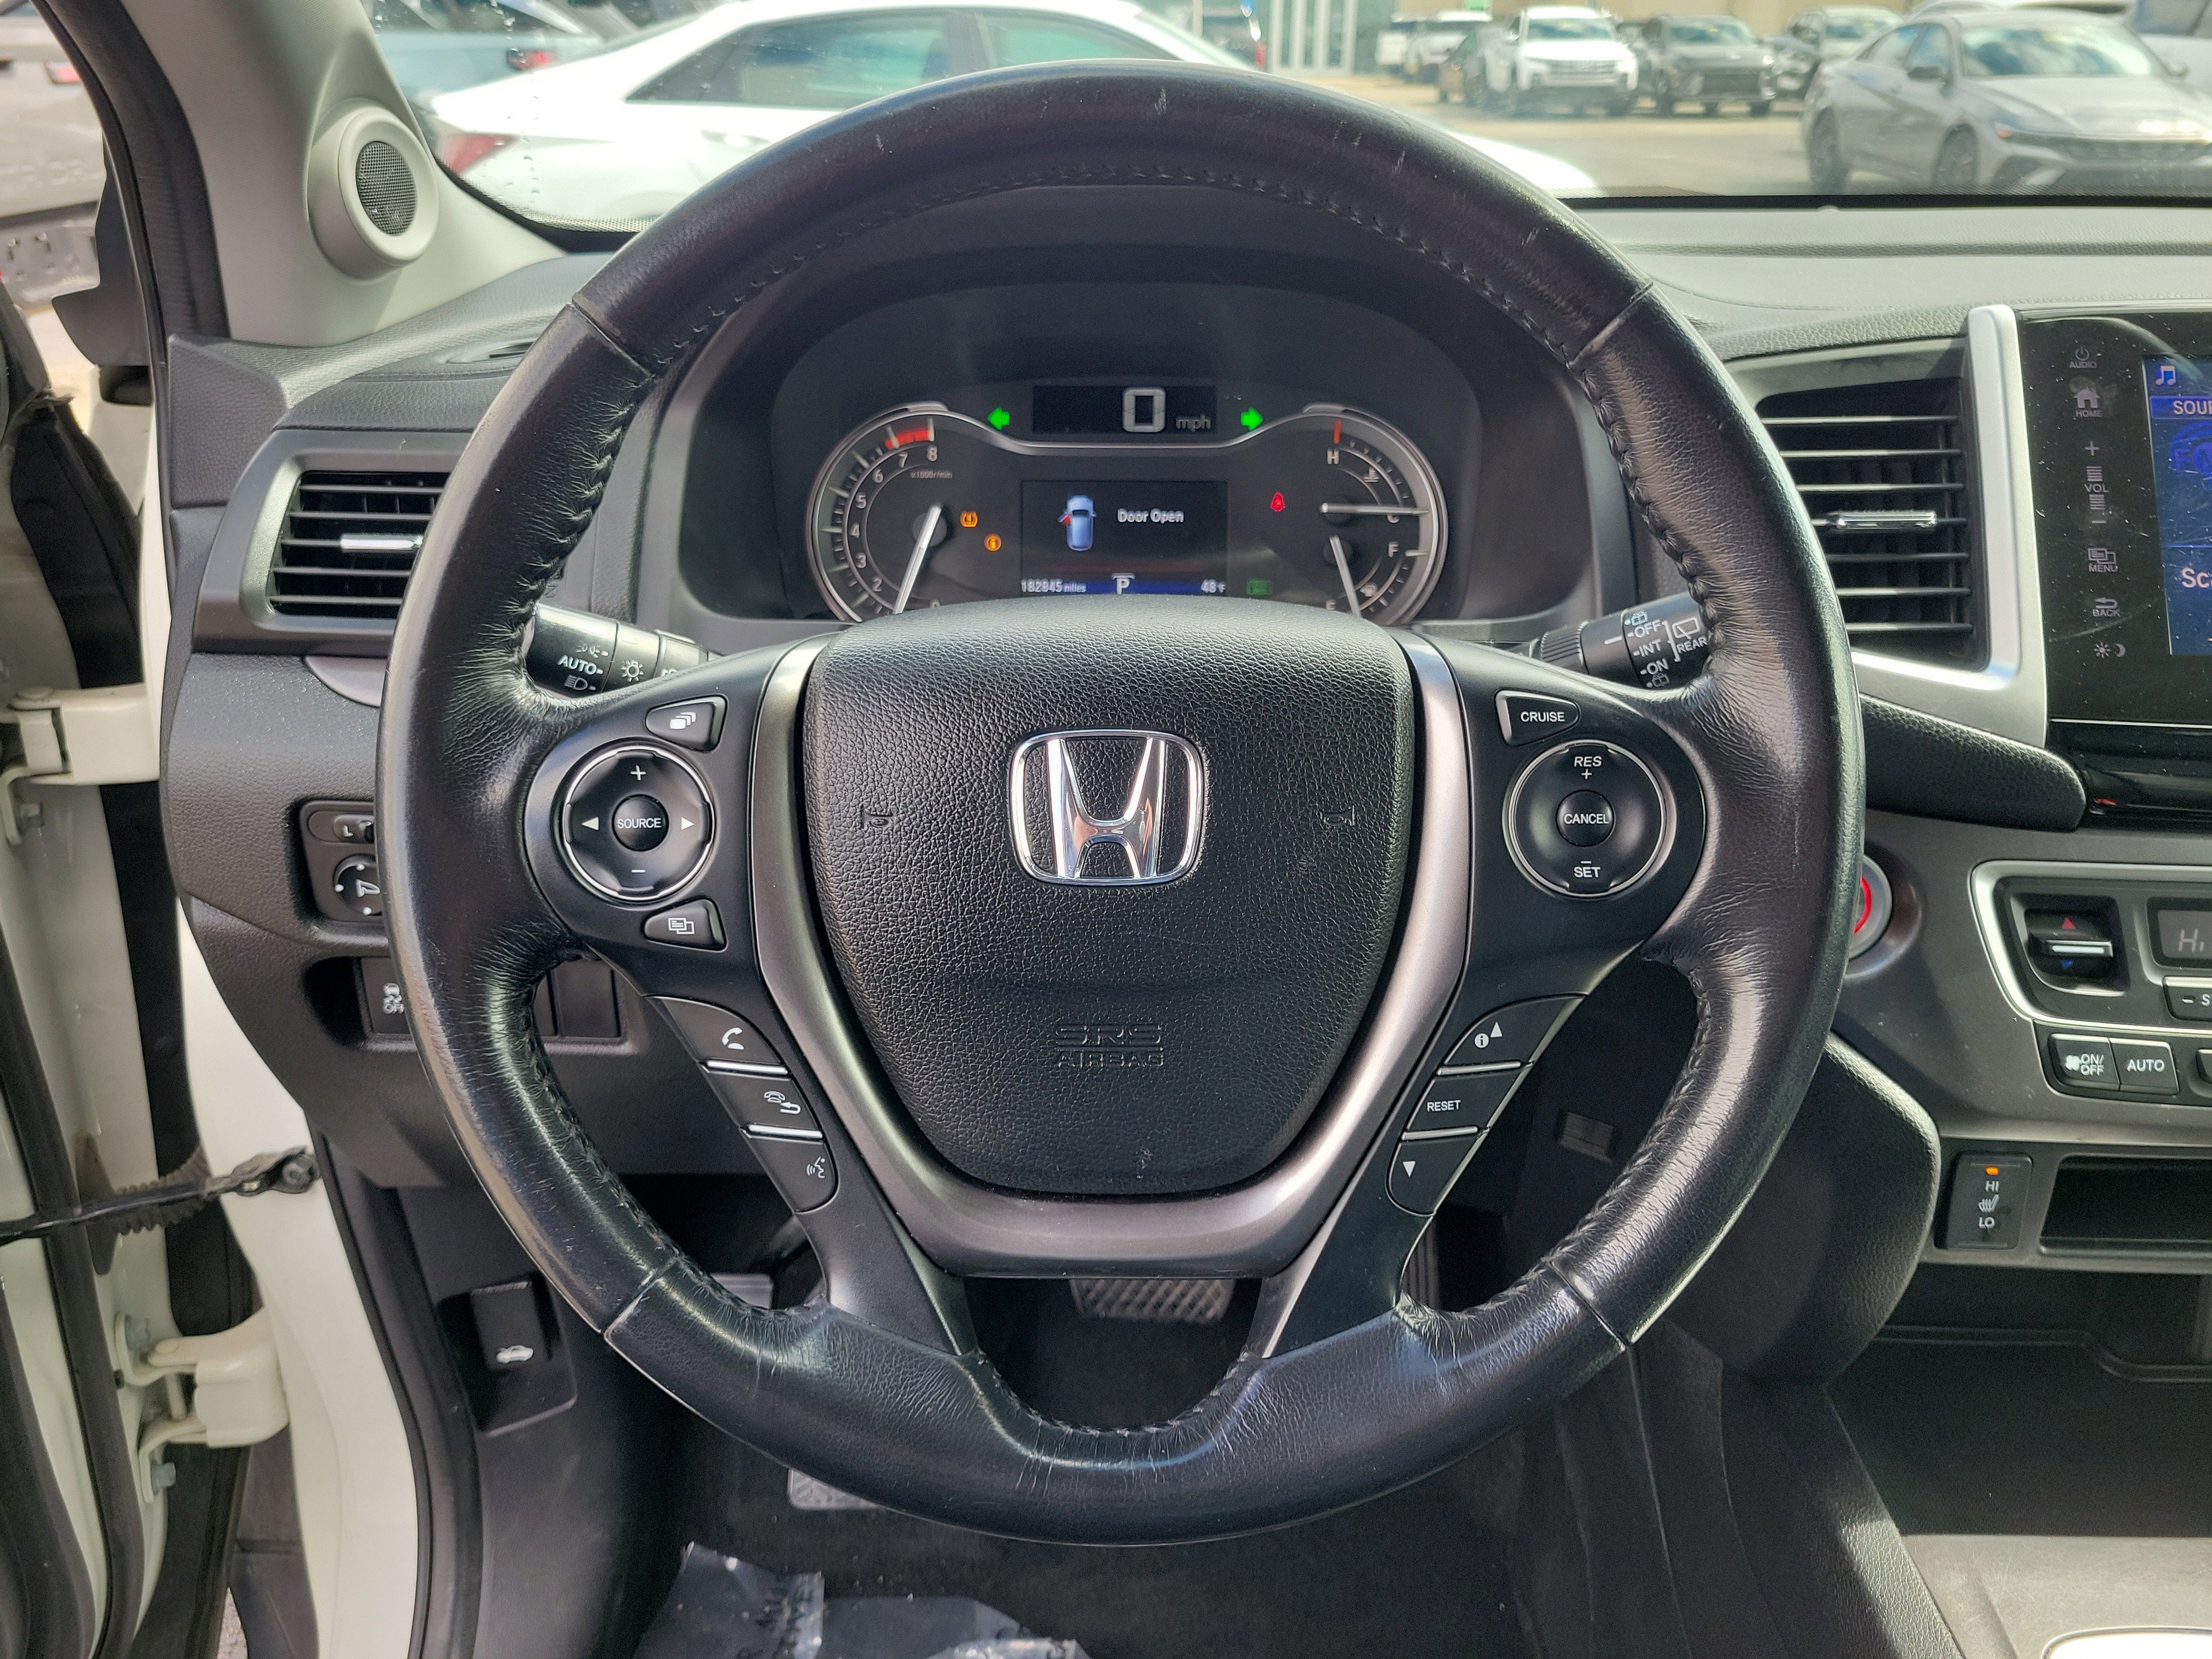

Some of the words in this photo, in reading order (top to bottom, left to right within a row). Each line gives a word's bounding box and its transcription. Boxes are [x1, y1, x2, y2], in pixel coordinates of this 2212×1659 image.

[1122, 387, 1166, 433] 0
[1176, 414, 1211, 433] mph
[2075, 410, 2103, 418] HOME
[898, 452, 909, 467] 7
[927, 444, 938, 462] 8
[1327, 448, 1340, 465] H
[872, 468, 884, 483] 6
[2084, 483, 2109, 493] VOL
[855, 494, 867, 509] 5
[1117, 508, 1149, 523] Door
[1150, 508, 1184, 524] Open
[851, 523, 860, 538] 4
[1388, 541, 1400, 557] F
[855, 552, 867, 568] 3
[2088, 563, 2119, 572] MENU
[873, 578, 883, 591] 2
[2181, 567, 2212, 588] Sc
[1063, 582, 1087, 592] miles
[1116, 577, 1130, 595] P
[2092, 609, 2121, 617] BACK
[1634, 619, 1662, 638] OFF
[1638, 639, 1662, 658] INT
[1675, 635, 1708, 654] REAR
[558, 654, 598, 675] AUTO
[1645, 658, 1669, 675] ON
[1520, 712, 1565, 723] CRUISE
[1573, 755, 1602, 768] RES
[617, 817, 662, 829] SOURCE
[1564, 813, 1610, 825] CANCEL
[1573, 866, 1601, 878] SET
[2201, 994, 2212, 1006] S
[1054, 1024, 1163, 1046] SRS
[1058, 1052, 1164, 1068] AIRBAG
[2126, 1058, 2165, 1073] AUTO
[2080, 1064, 2104, 1076] OFF
[1426, 1099, 1462, 1113] RESET
[1985, 1181, 2000, 1193] HI
[1978, 1217, 1995, 1229] LO
